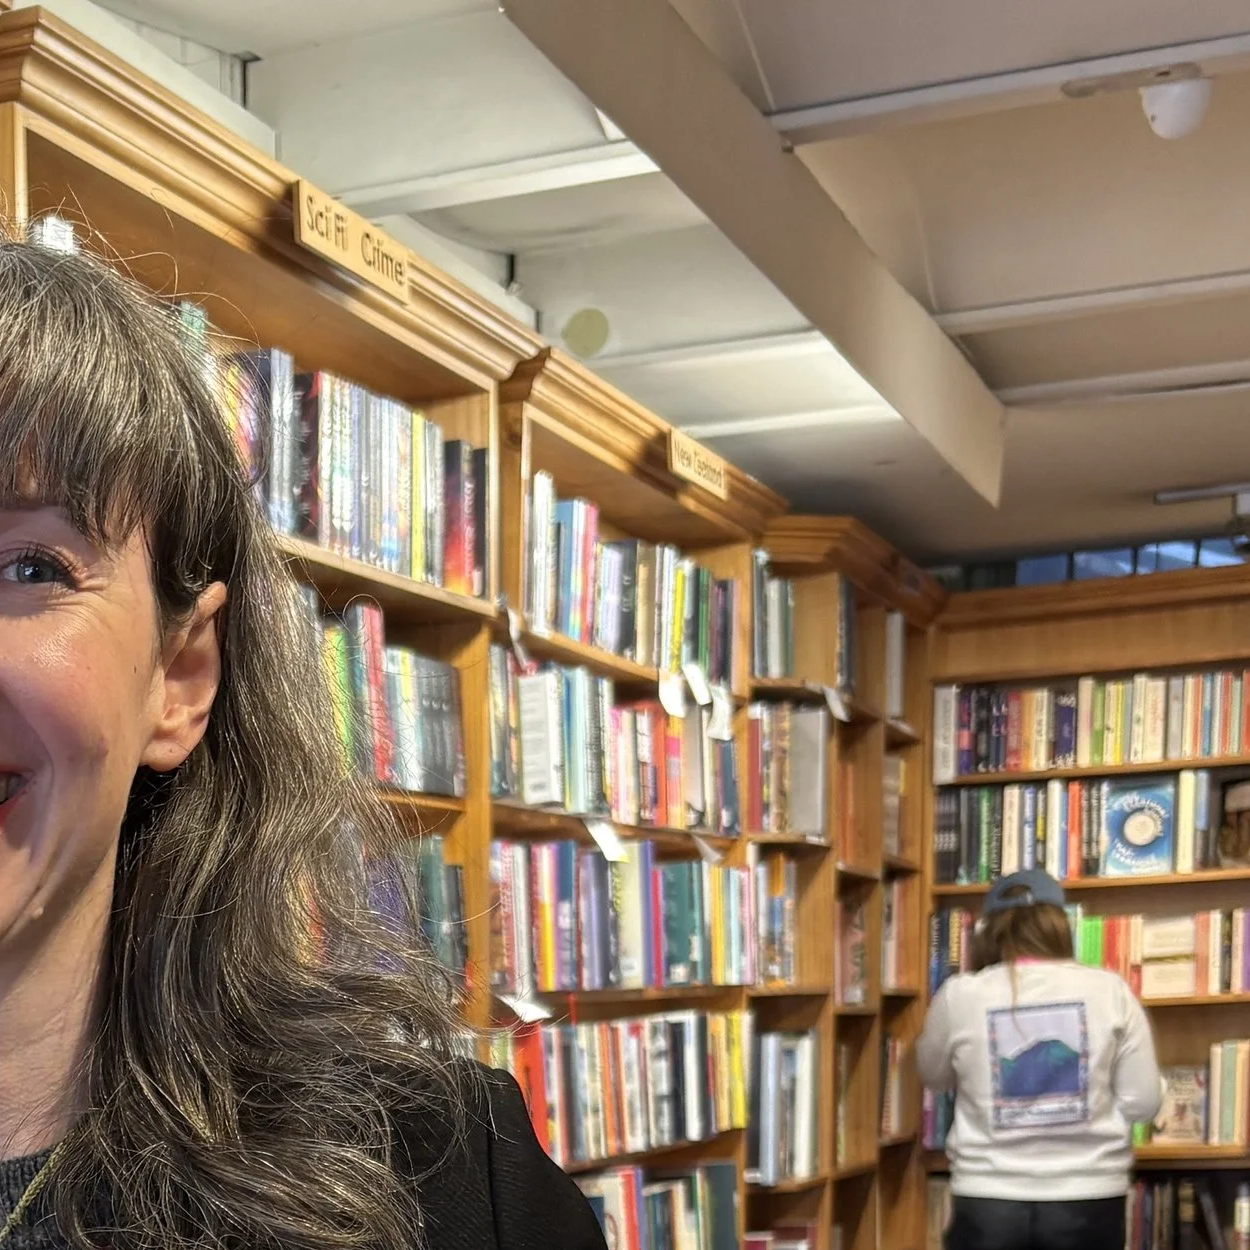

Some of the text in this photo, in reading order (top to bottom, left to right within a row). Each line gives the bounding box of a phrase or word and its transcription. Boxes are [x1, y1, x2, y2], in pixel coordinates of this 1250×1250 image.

[306, 195, 348, 252] Sci Fi
[360, 231, 406, 287] Crime
